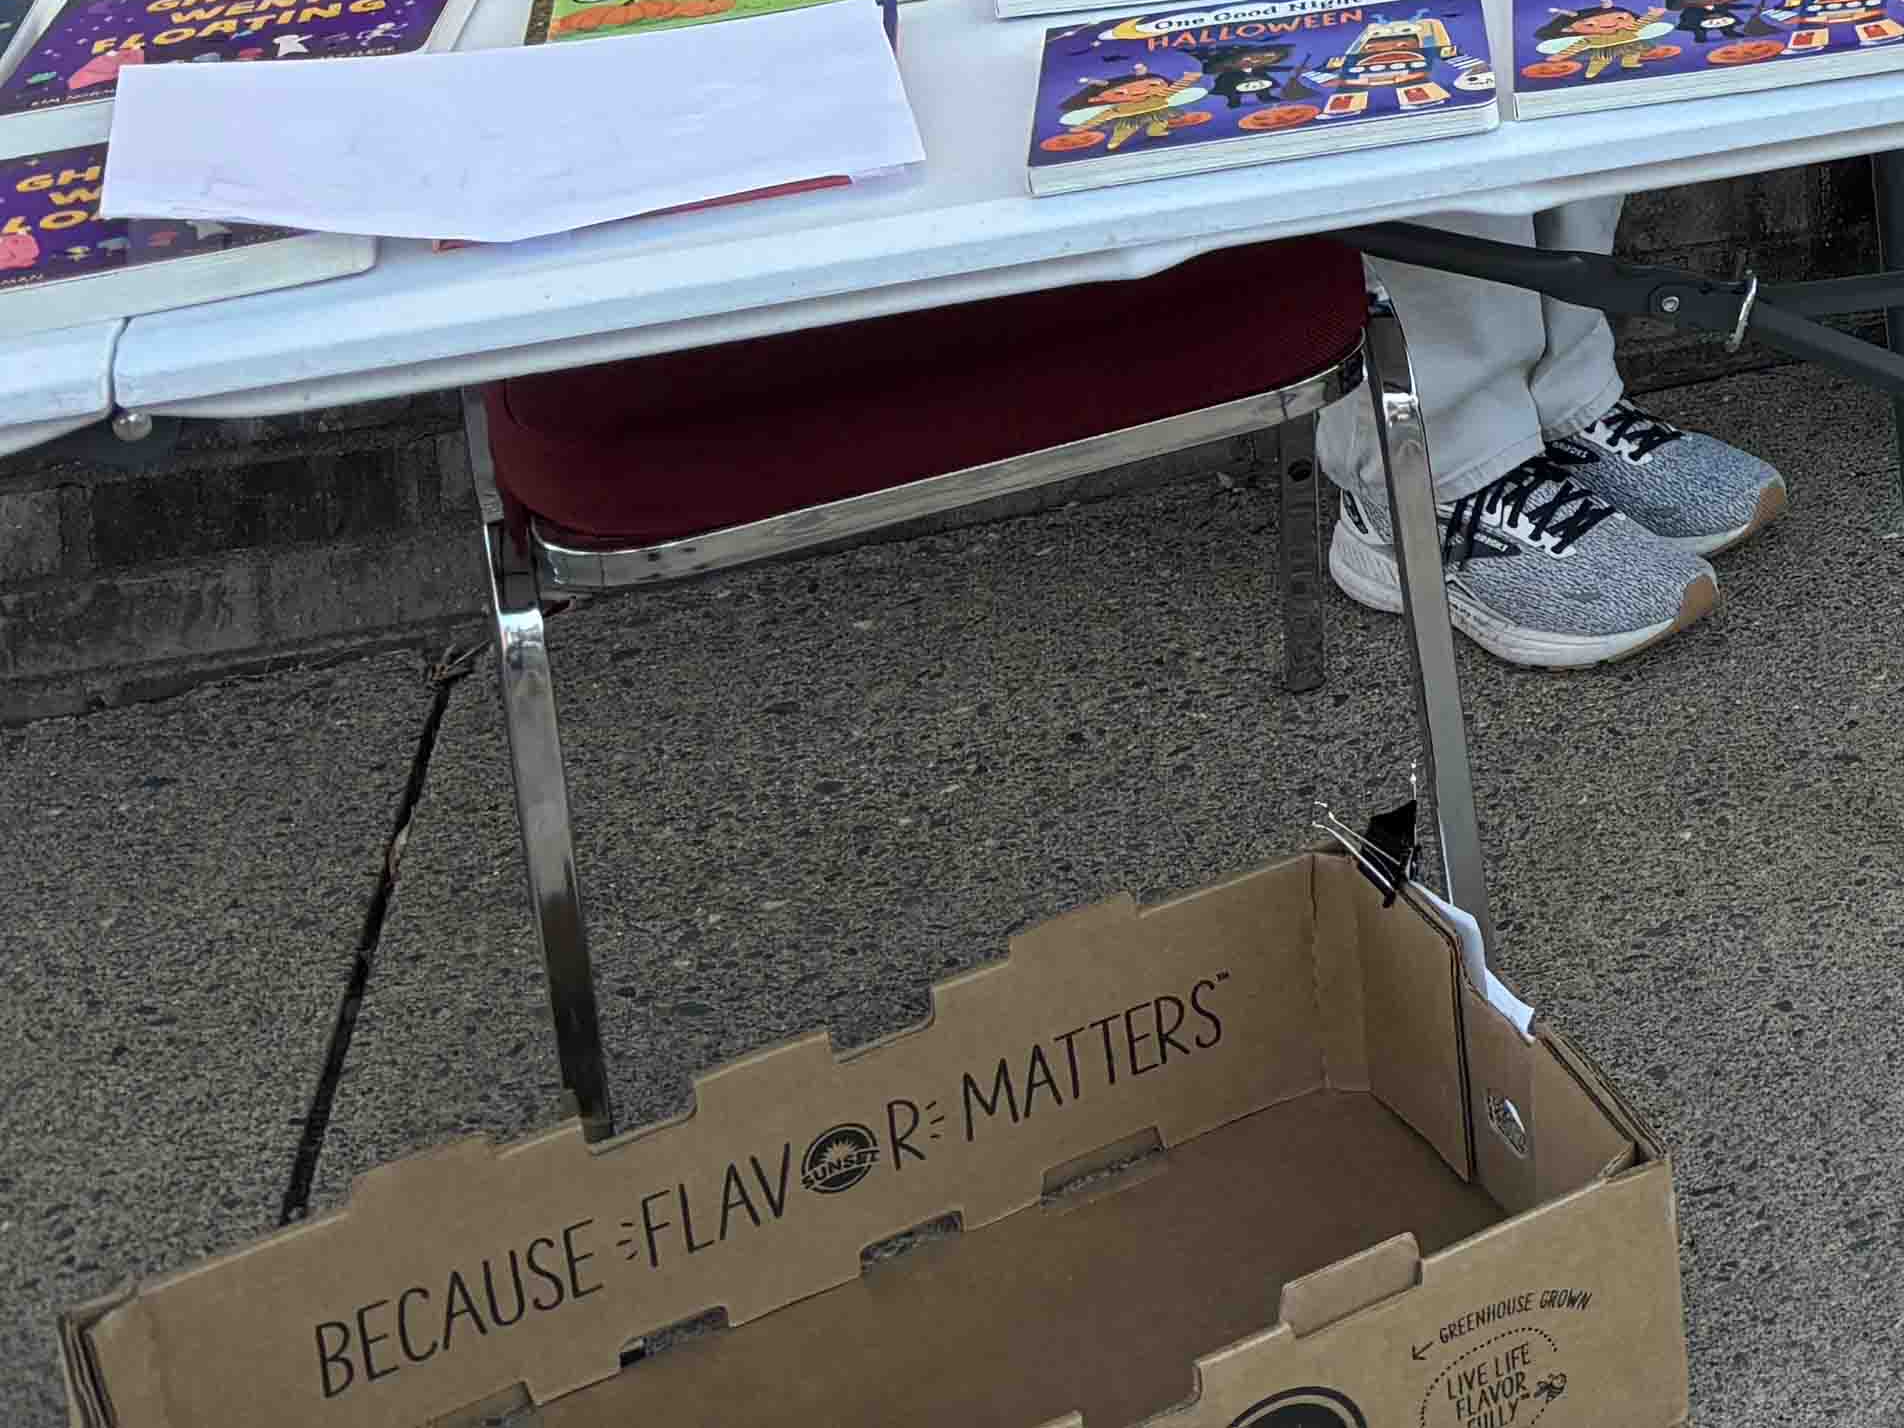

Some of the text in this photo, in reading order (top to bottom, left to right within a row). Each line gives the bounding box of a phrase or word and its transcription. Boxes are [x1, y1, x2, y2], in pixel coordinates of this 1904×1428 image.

[1146, 9, 1365, 52] HALLOWEEN
[1153, 12, 1207, 32] One
[1212, 3, 1279, 22] Good
[800, 1146, 882, 1192] SUNSET
[314, 1217, 605, 1400] BECAUSE
[1439, 1287, 1594, 1346] GREENHOUSE GROWN
[1446, 1341, 1533, 1401] LIVE LIFE
[1455, 1371, 1529, 1420] FLAVOR
